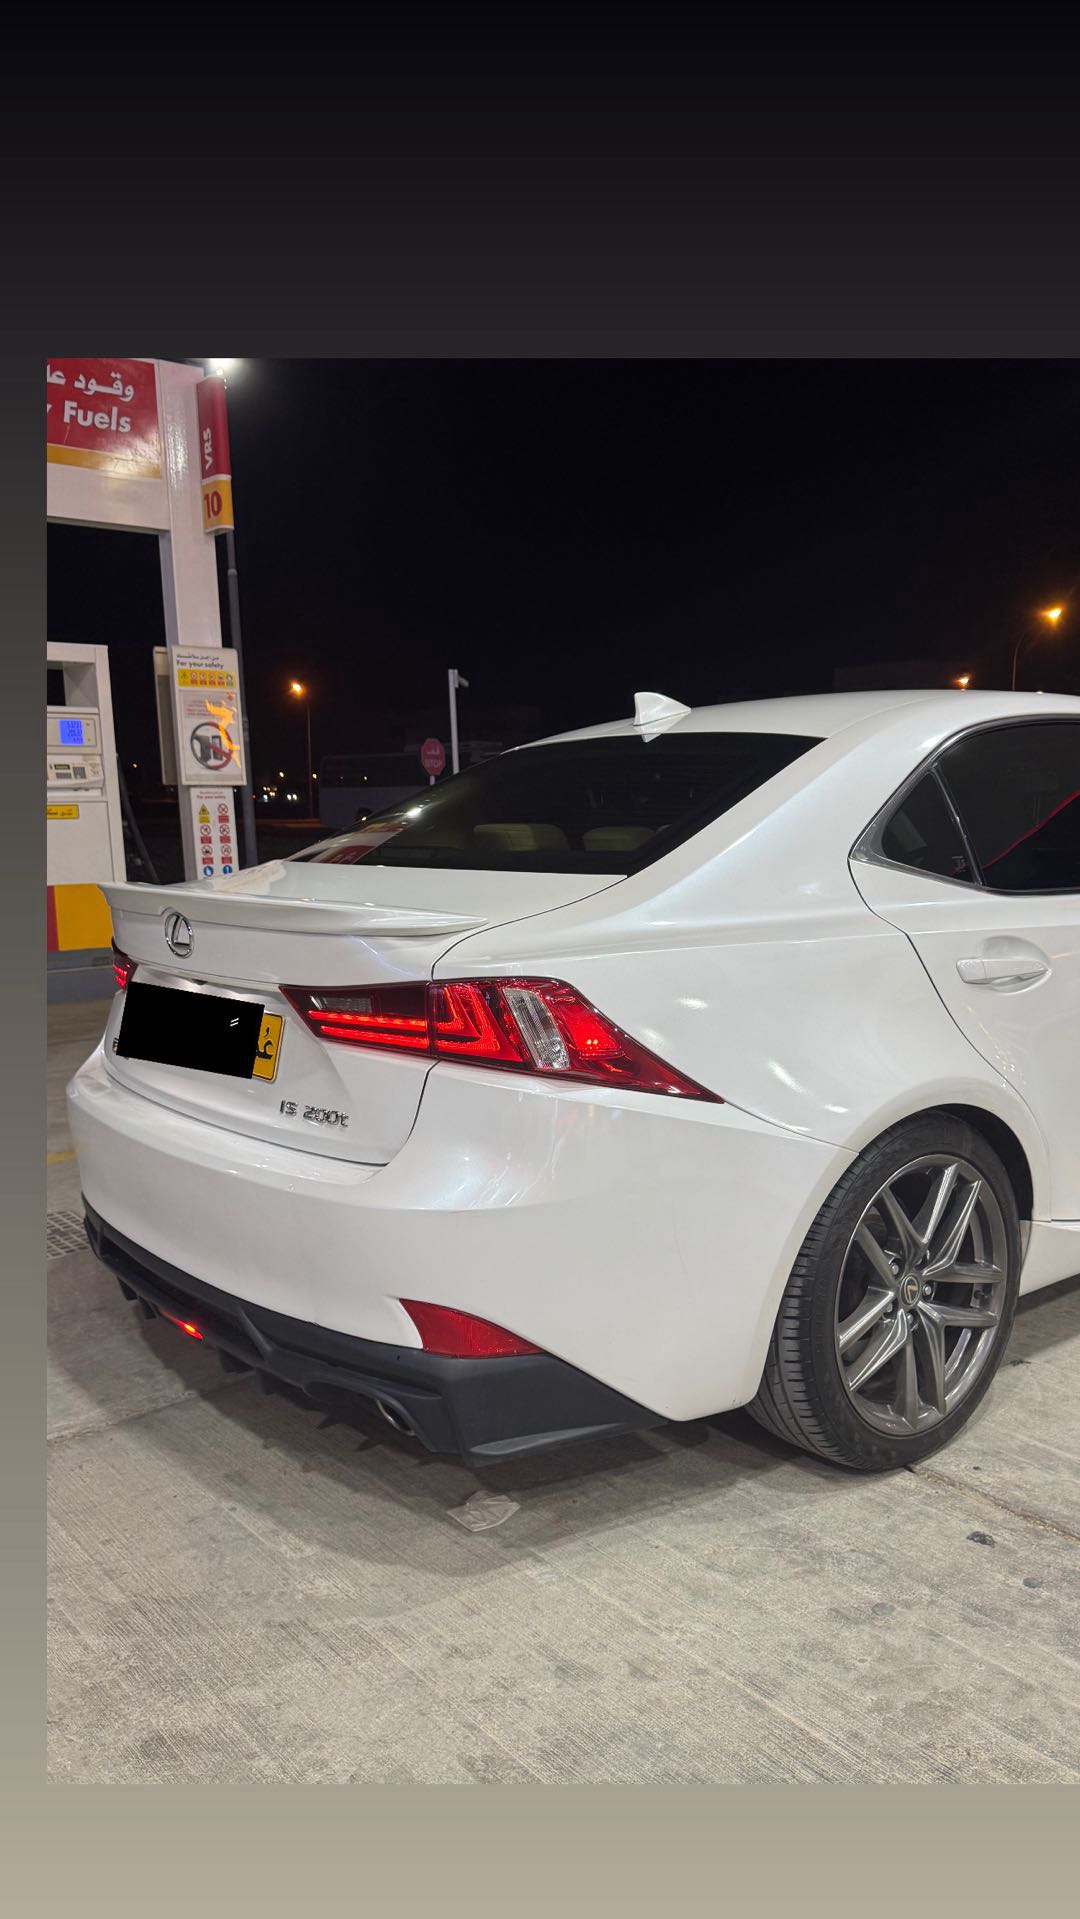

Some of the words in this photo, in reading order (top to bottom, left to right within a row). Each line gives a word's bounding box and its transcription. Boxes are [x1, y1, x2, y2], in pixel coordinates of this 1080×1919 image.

[74, 371, 134, 402] وقود
[63, 400, 131, 433] Fuels
[203, 427, 212, 470] VRS
[203, 490, 222, 519] 10
[205, 661, 224, 670] safety
[279, 1100, 298, 1116] IS
[303, 1105, 349, 1128] 200t
